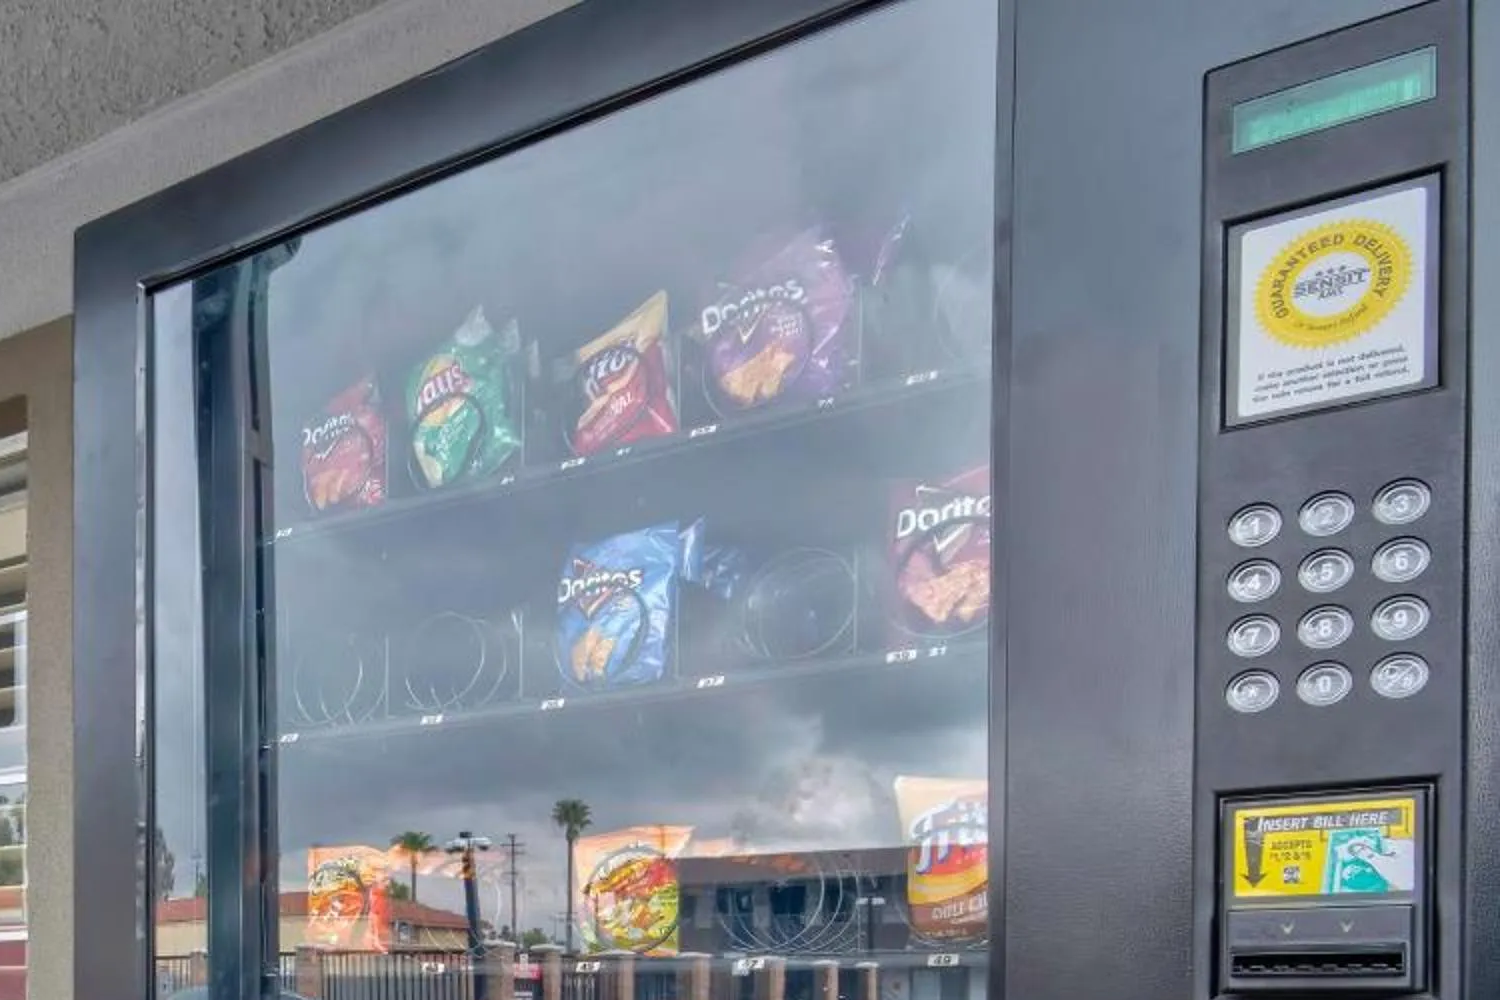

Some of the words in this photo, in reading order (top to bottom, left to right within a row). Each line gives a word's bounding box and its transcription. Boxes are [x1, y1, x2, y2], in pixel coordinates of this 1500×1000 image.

[1271, 233, 1345, 319] GUARANTEED
[1353, 233, 1393, 298] DELIVERY
[896, 495, 991, 539] Dorito
[1250, 518, 1262, 536] 1
[1395, 494, 1409, 512] 3
[1320, 563, 1334, 582] 5
[1394, 552, 1409, 571] 6
[1248, 627, 1262, 645] 7
[1320, 619, 1333, 637] 8
[1393, 609, 1408, 628] 9
[1257, 816, 1309, 833] INSERT
[1313, 813, 1342, 829] BILL
[1350, 811, 1390, 826] HERE
